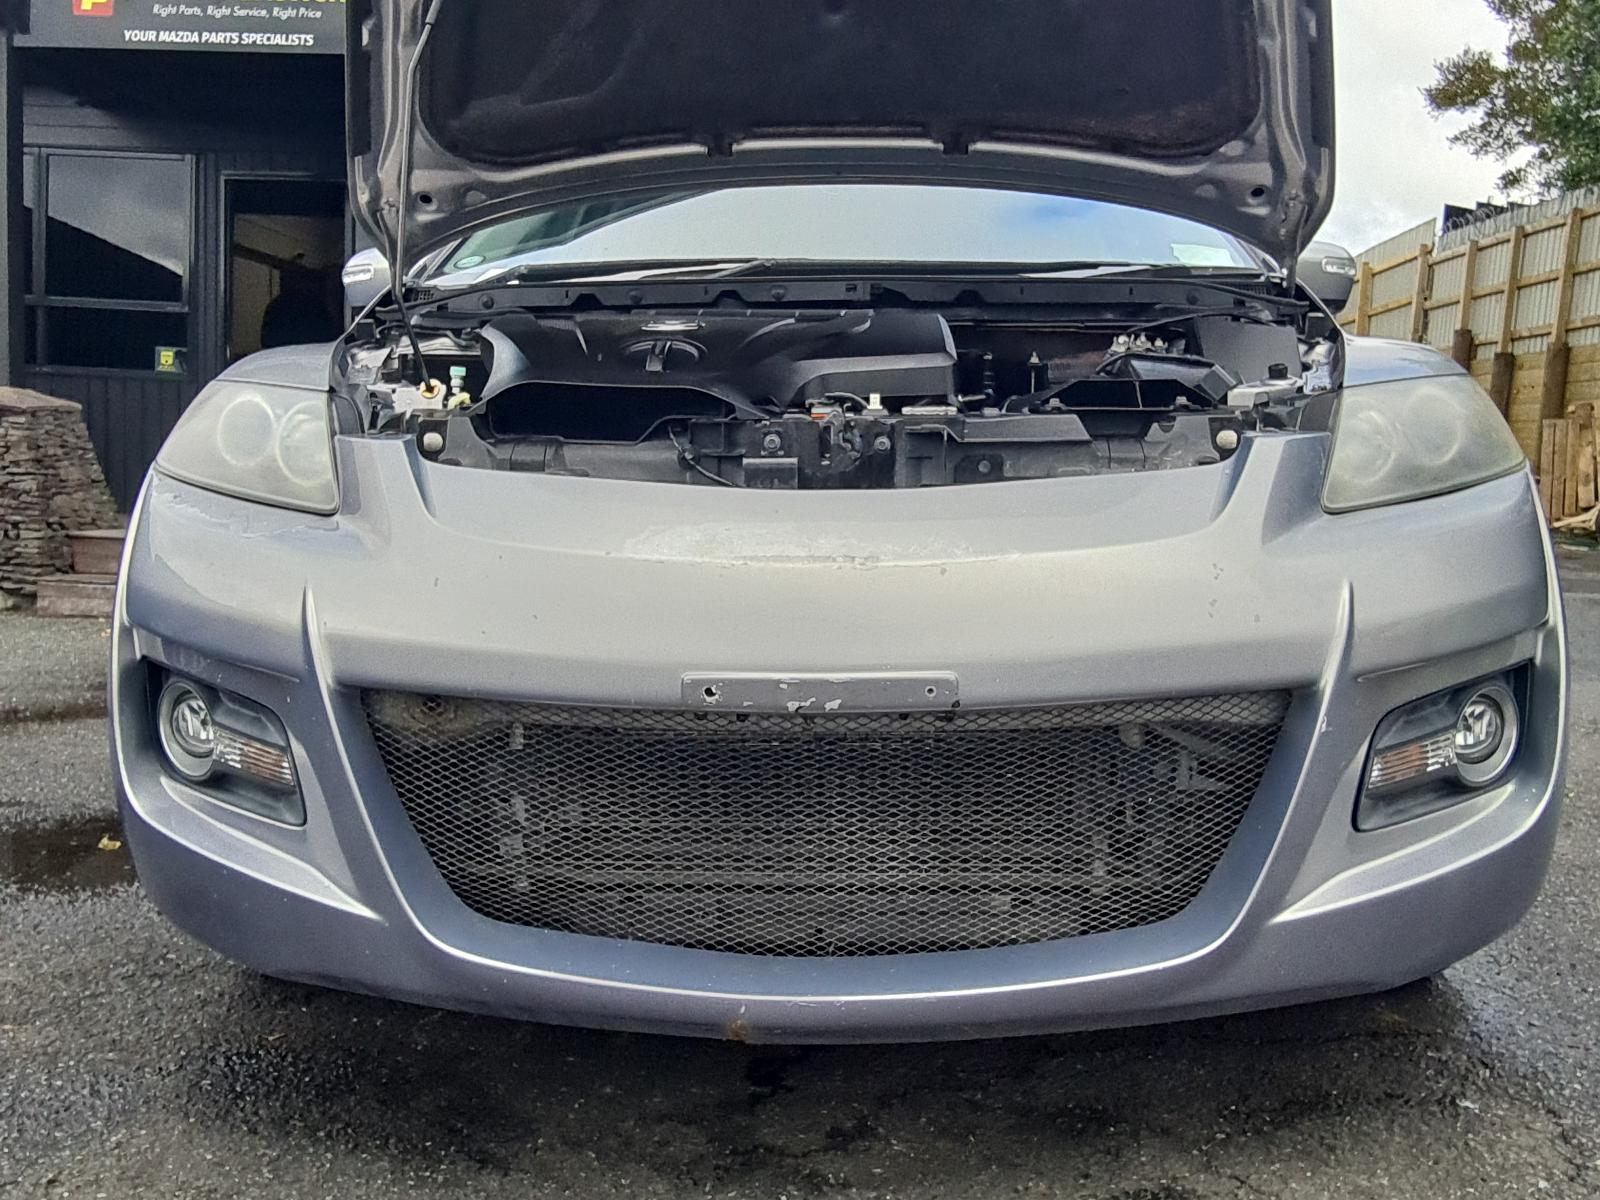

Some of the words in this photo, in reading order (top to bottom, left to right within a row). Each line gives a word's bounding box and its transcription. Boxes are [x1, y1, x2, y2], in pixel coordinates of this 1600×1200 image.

[152, 3, 178, 18] Right
[178, 4, 204, 17] Parts,
[206, 5, 231, 19] Right
[232, 5, 270, 19] Service,
[272, 6, 297, 20] Right
[298, 6, 322, 18] Price
[123, 29, 157, 42] YOUR
[158, 30, 199, 44] MAZDA
[201, 31, 240, 45] PARTS
[240, 32, 314, 46] SPECIALISTS
